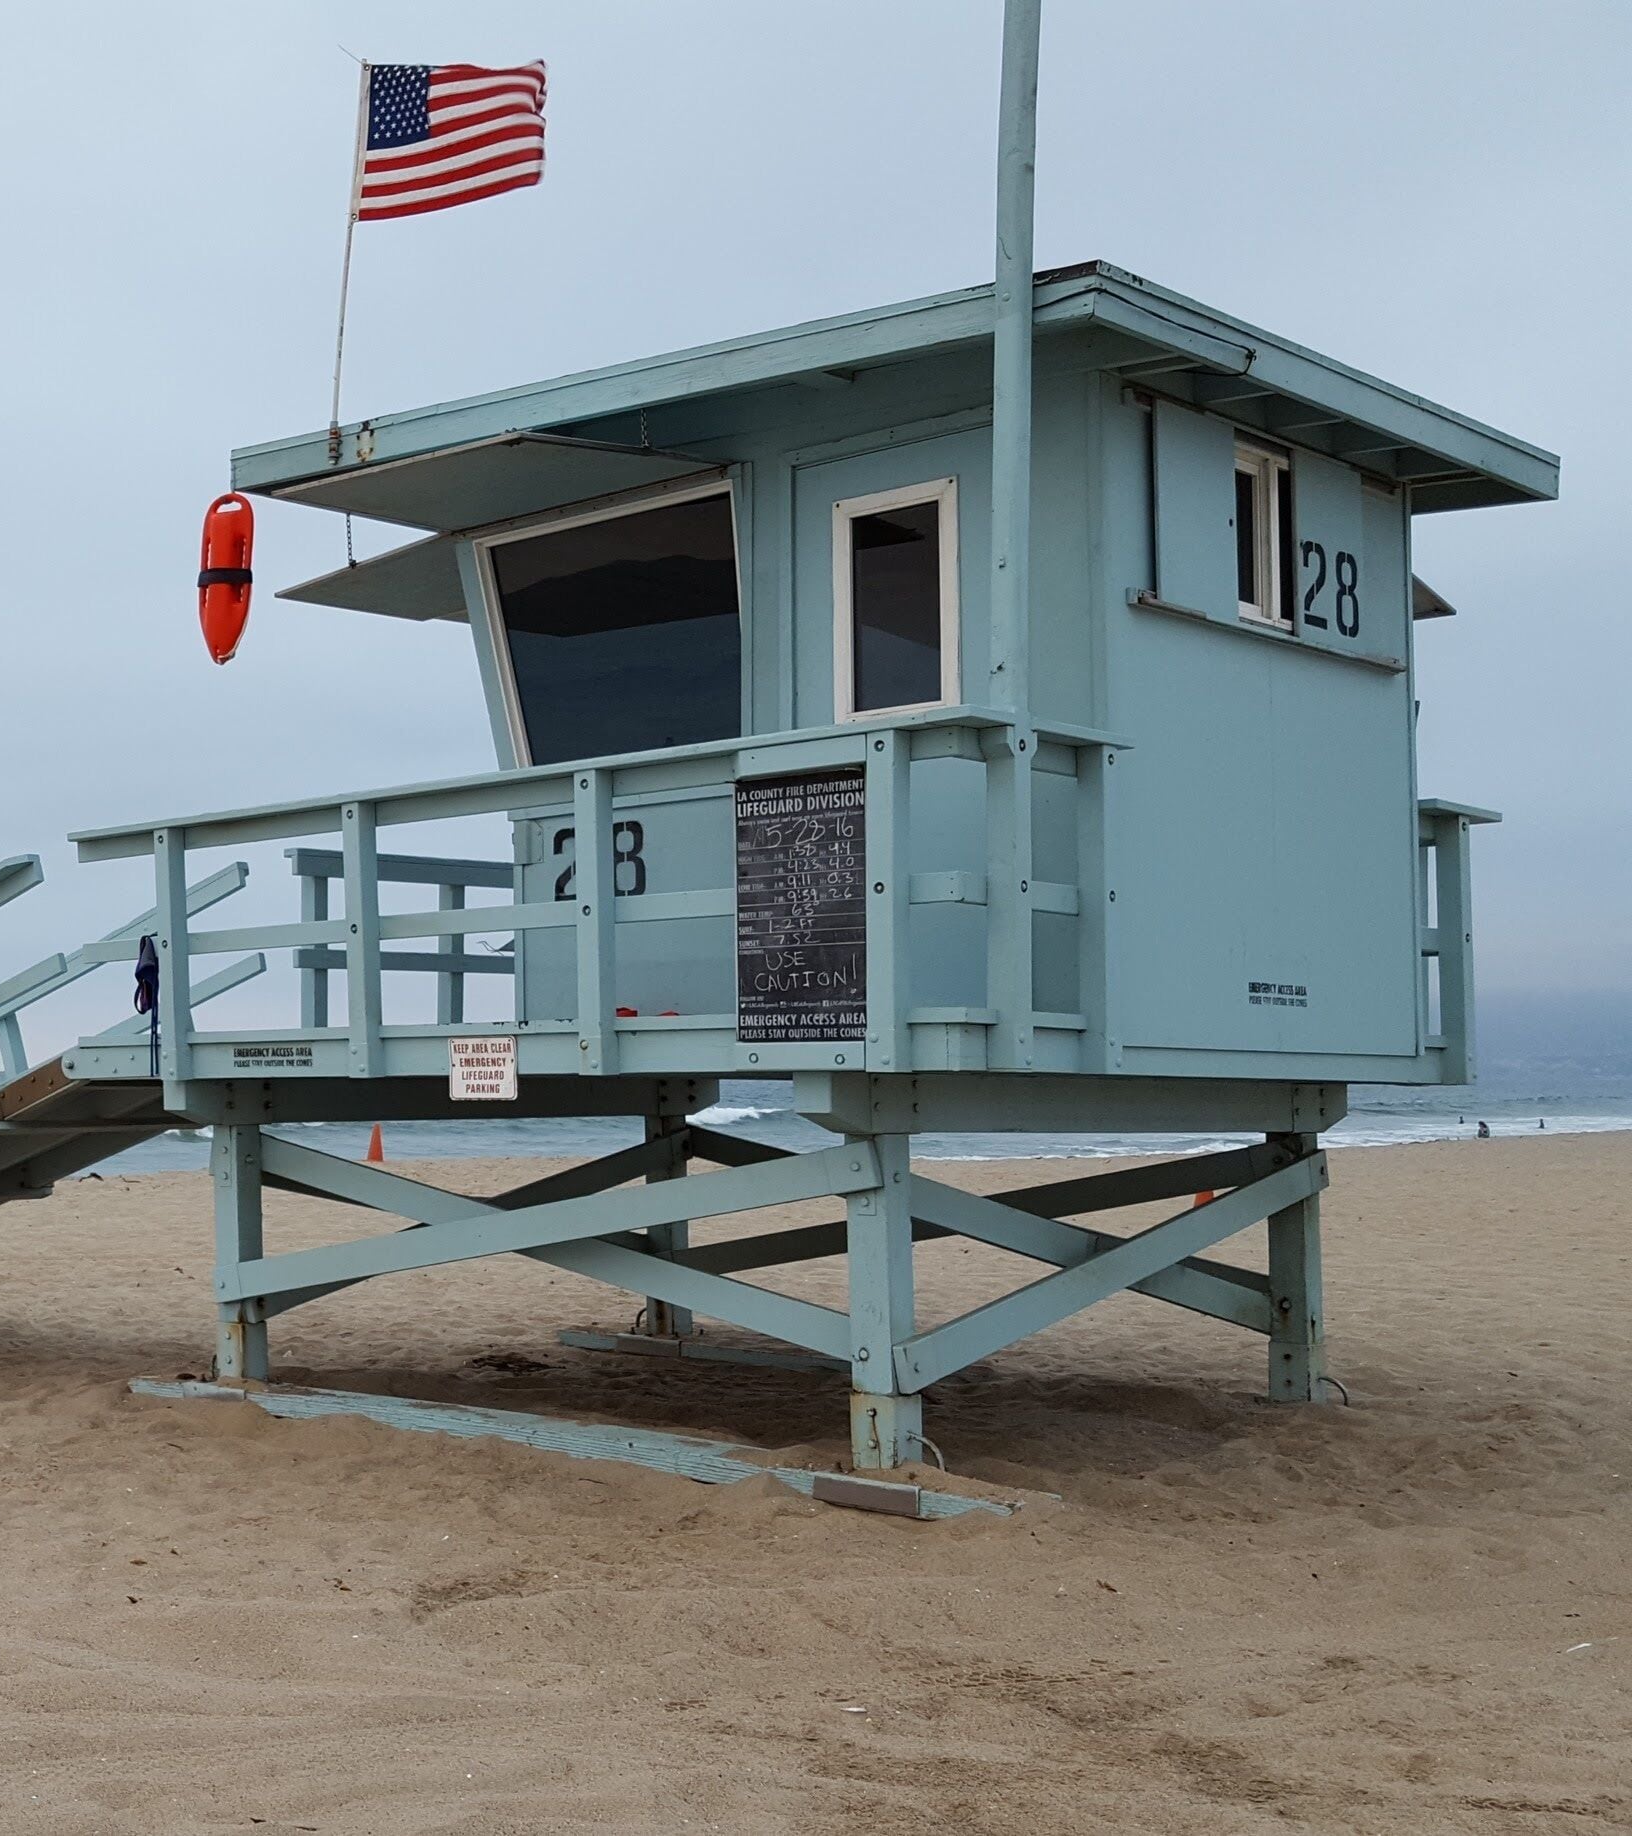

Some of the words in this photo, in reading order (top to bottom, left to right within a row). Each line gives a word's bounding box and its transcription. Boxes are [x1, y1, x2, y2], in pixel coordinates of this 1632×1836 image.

[1302, 541, 1360, 638] 28
[737, 791, 747, 801] LA
[750, 787, 783, 800] COUNTY
[786, 785, 804, 797] FIRE
[807, 779, 864, 794] DEPARTMENT
[737, 798, 803, 817] LIFEGUARD
[807, 791, 864, 810] DIVISION
[788, 858, 819, 872] 4:23
[829, 857, 854, 869] 4.0
[788, 873, 811, 888] 9:11
[788, 889, 817, 902] 9:59
[766, 951, 806, 971] USE
[740, 1014, 797, 1027] EMERGENCY
[800, 1012, 835, 1025] ACCESS
[839, 1012, 866, 1025] AREA
[740, 1029, 766, 1039] PLEASE
[768, 1029, 786, 1038] STAY
[788, 1028, 821, 1038] OUTSIDE
[823, 1028, 838, 1037] THE
[840, 1027, 866, 1037] CONES
[234, 1048, 269, 1057] EMERGENCY
[271, 1047, 294, 1057] ACCESS
[295, 1047, 312, 1057] AREA
[453, 1043, 469, 1053] KEEP
[471, 1043, 488, 1053] AREA
[491, 1043, 511, 1053] CLEAR
[459, 1057, 506, 1067] EMERGENCY
[462, 1070, 504, 1080] LIFEGUARD
[466, 1083, 500, 1093] PARKING
